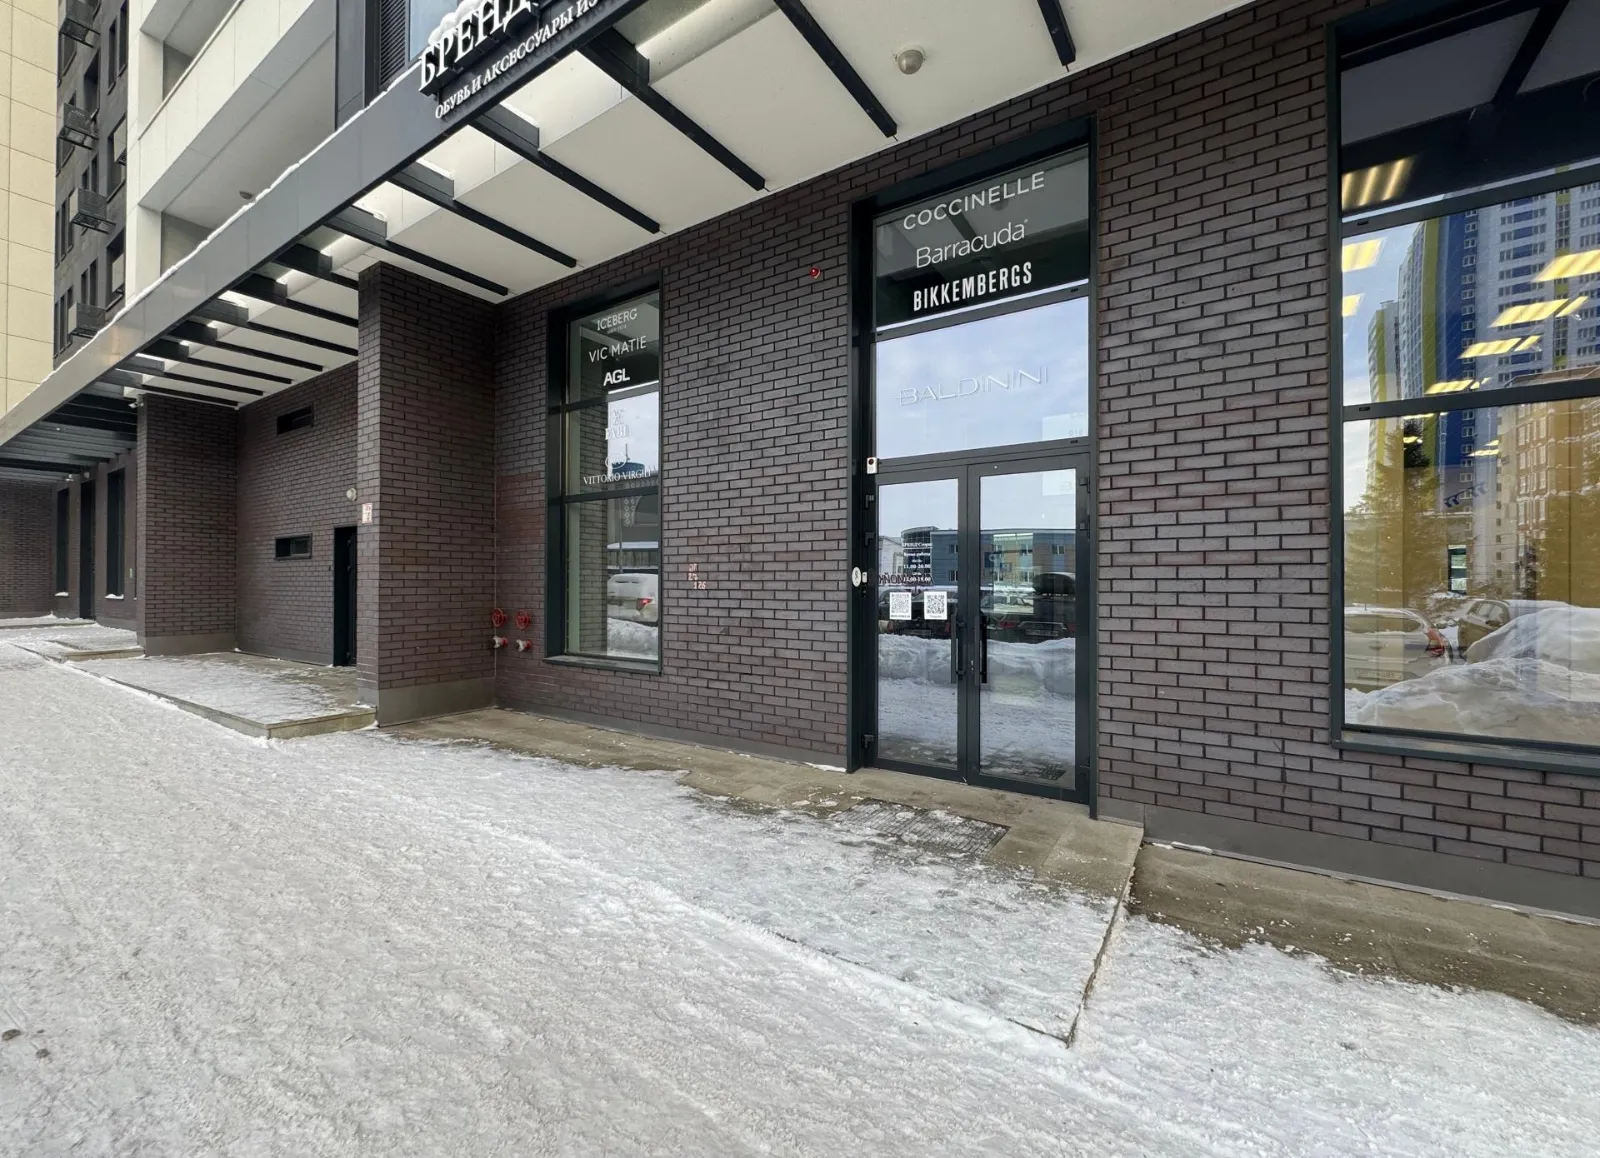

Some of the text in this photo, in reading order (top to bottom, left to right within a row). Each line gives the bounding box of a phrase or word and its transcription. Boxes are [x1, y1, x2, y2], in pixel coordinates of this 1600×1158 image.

[435, 84, 471, 119] ОБУВЬ
[470, 75, 483, 93] И
[483, 6, 574, 87] АКСЕССУАРЫ
[903, 171, 1045, 230] COCCINELLE
[916, 222, 1025, 269] Barracuda
[913, 262, 1032, 312] BIKKEMBERGS
[597, 308, 638, 331] ICEBERG
[589, 335, 646, 363] VIC MATIE
[603, 368, 631, 387] AGL
[898, 366, 1049, 406] BALDININI
[583, 471, 621, 485] VITTORIO
